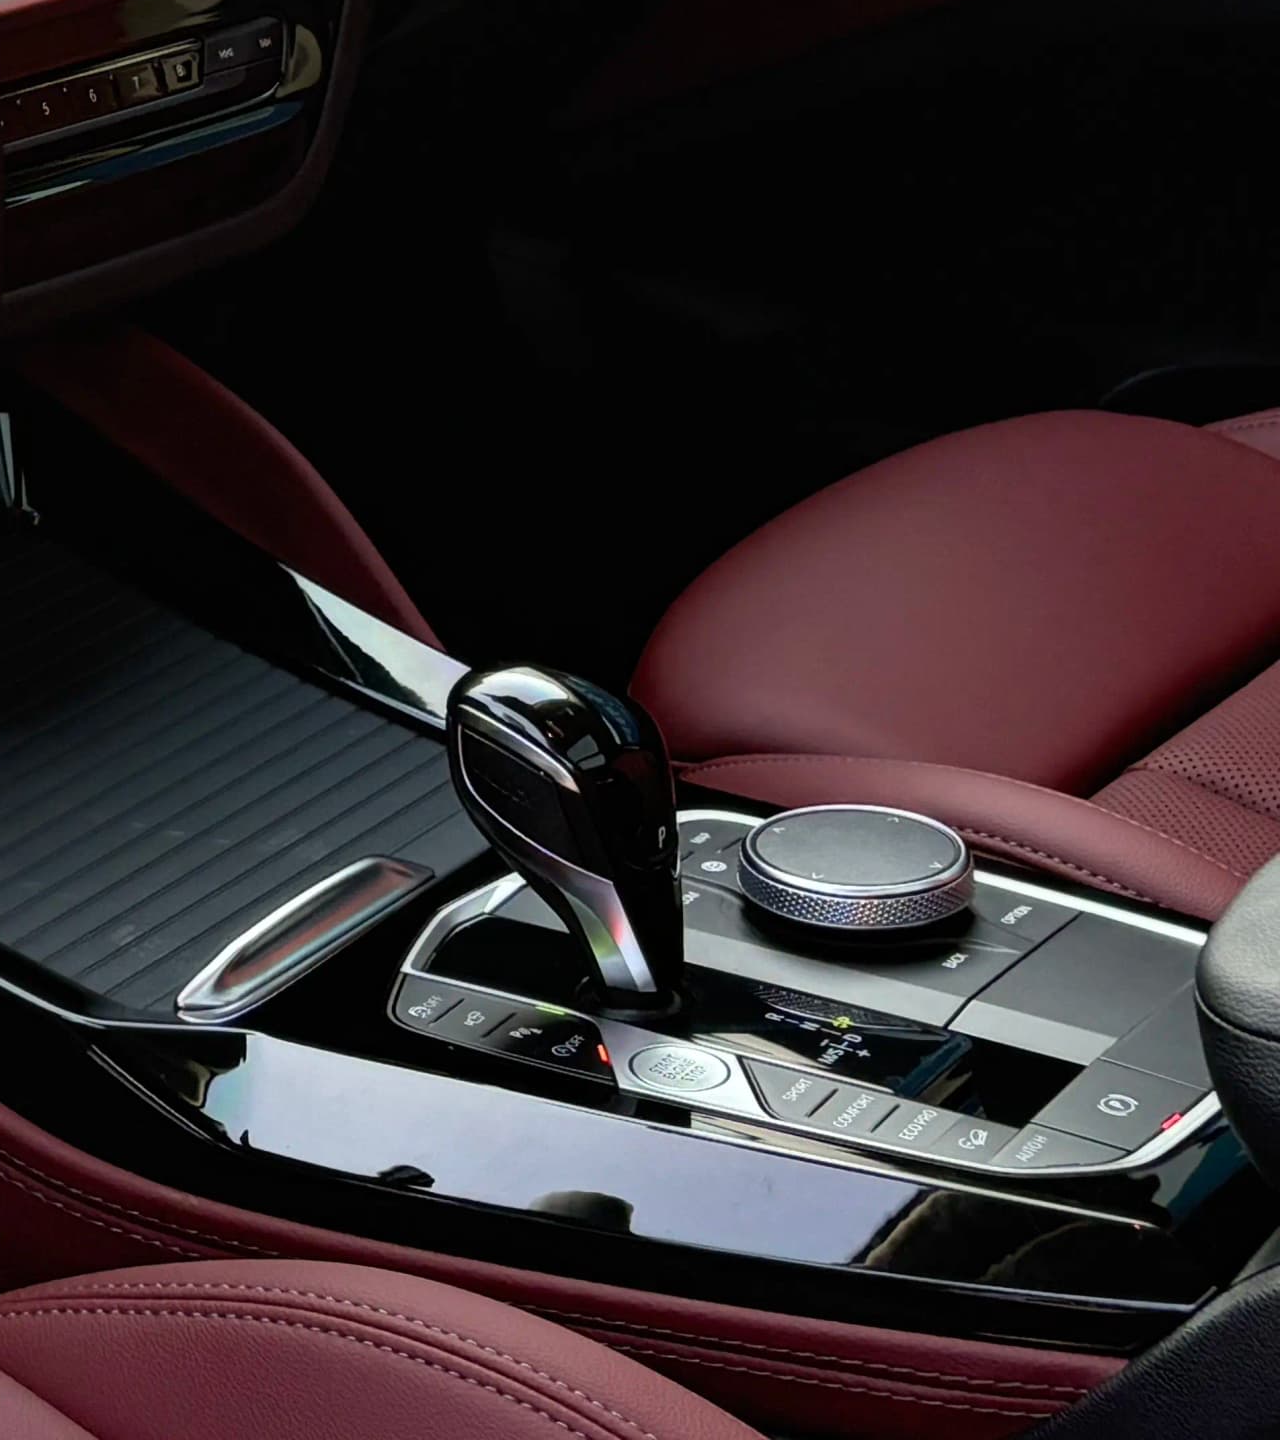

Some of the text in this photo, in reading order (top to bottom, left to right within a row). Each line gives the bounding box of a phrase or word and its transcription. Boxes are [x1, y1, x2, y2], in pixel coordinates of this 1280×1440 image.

[89, 89, 97, 103] 6
[42, 102, 50, 116] 5
[658, 826, 666, 848] P
[941, 952, 969, 969] BACK
[648, 1053, 680, 1075] START
[782, 1077, 813, 1102] SPORT
[832, 1093, 875, 1128] COMFORT
[898, 1109, 939, 1141] ECO PRO
[1015, 1140, 1041, 1162] AUTO
